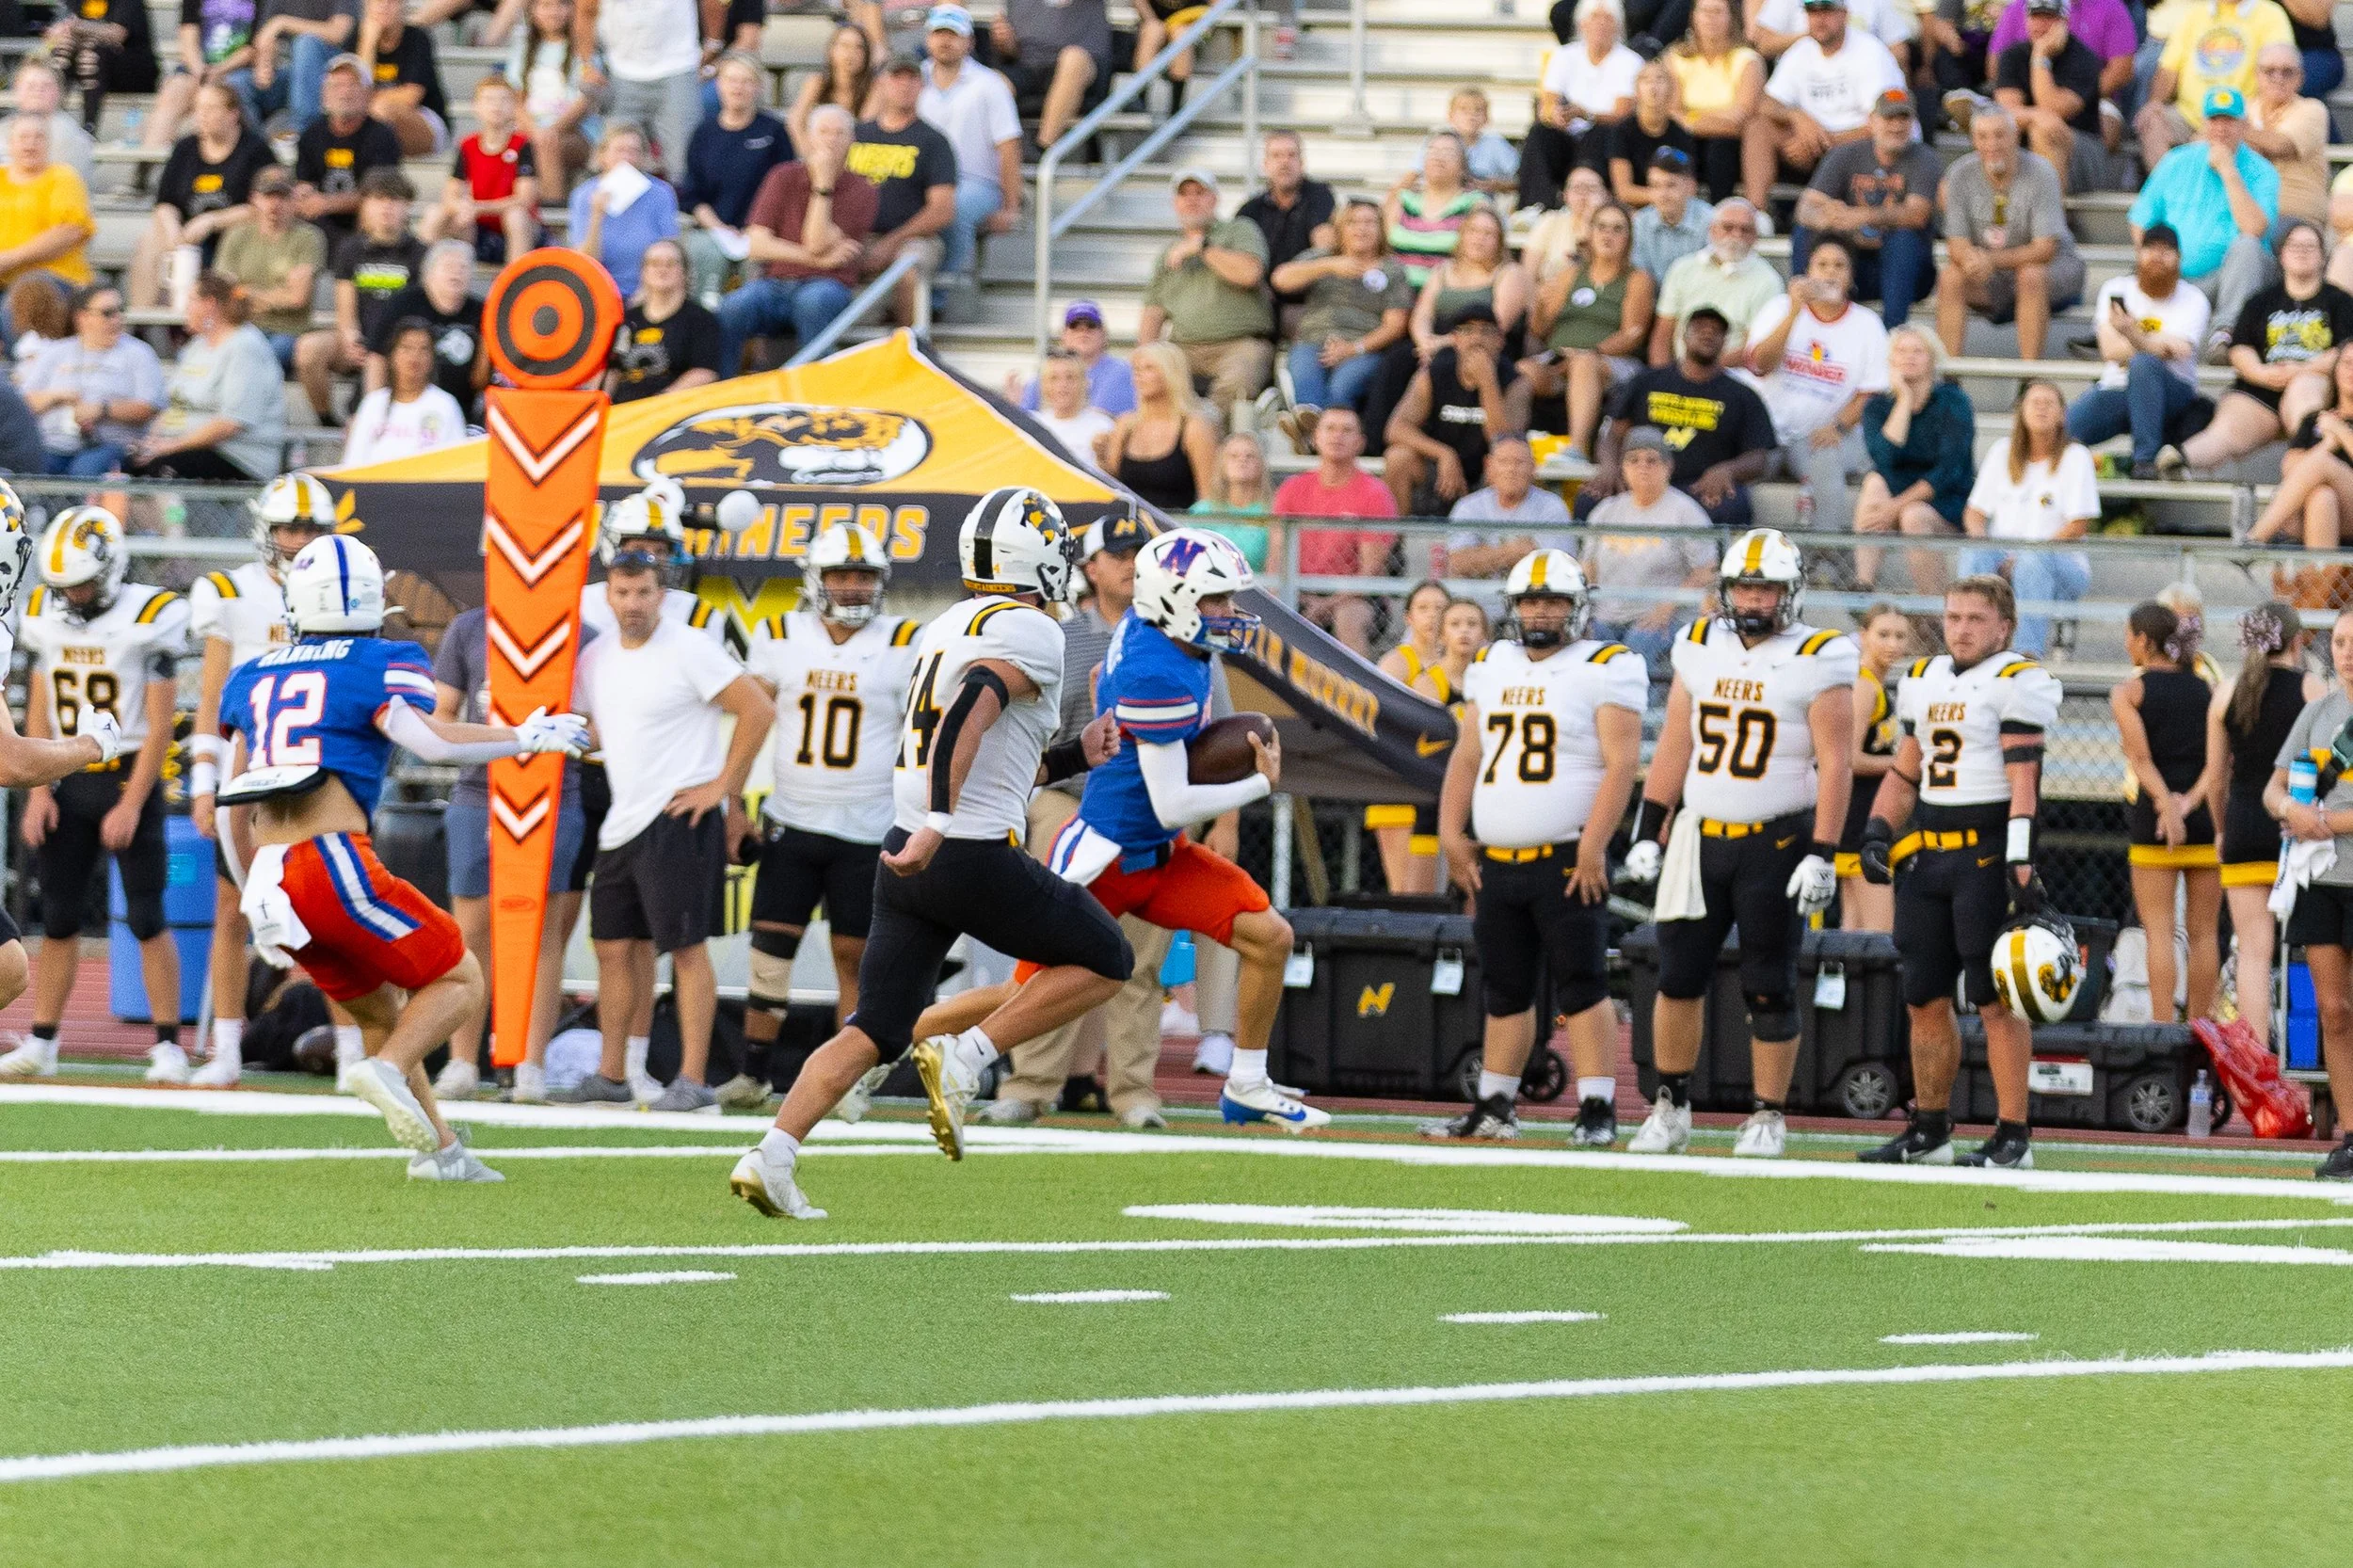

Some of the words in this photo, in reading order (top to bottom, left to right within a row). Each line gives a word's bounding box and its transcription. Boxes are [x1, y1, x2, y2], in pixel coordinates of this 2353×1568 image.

[1159, 536, 1209, 580] N
[807, 668, 858, 692] NEERS
[1501, 685, 1546, 706] NEERS
[1714, 677, 1765, 702] NEERS
[248, 670, 328, 772] 12
[794, 692, 863, 769] 10
[1927, 701, 1966, 724] NEERS
[1482, 711, 1558, 785] 78
[1697, 700, 1778, 780] 50
[1928, 727, 1962, 789] 2
